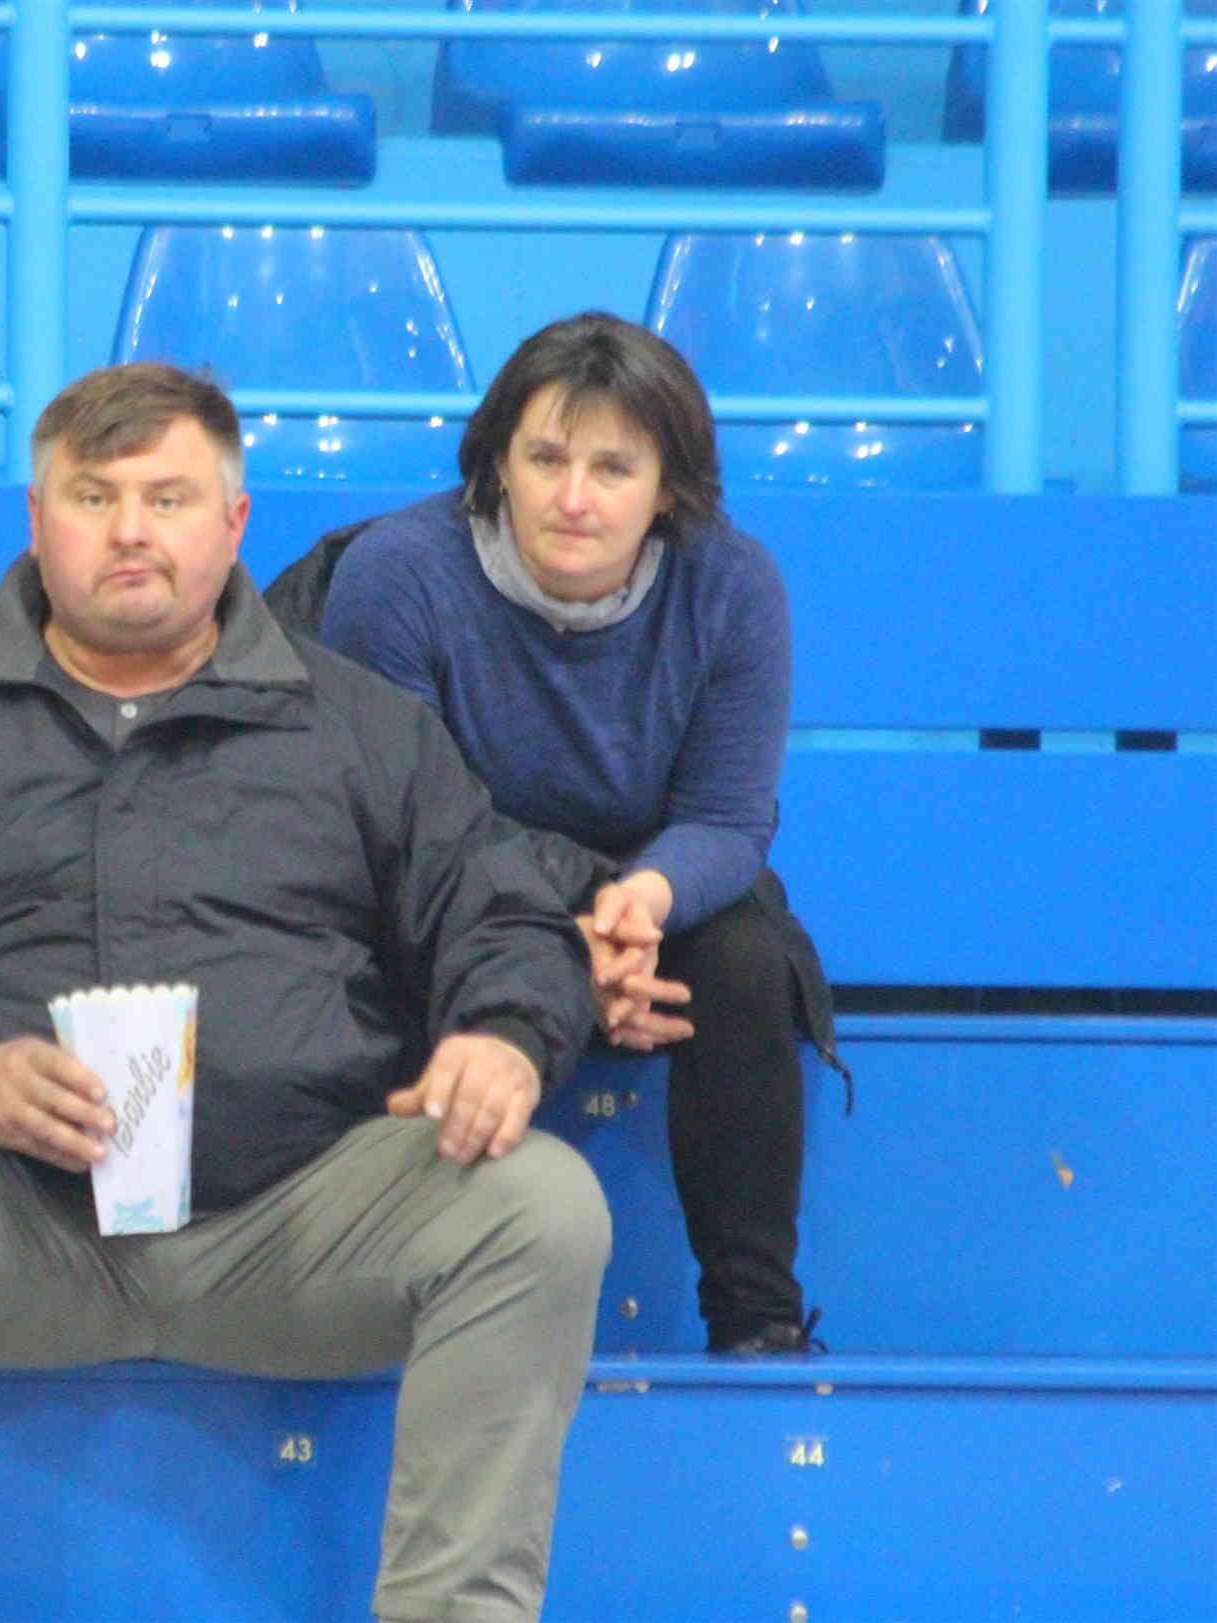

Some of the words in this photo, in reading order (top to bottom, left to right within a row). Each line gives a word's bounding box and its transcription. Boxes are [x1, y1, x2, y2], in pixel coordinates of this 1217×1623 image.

[585, 1094, 615, 1117] 48
[280, 1438, 311, 1462] 43
[790, 1440, 824, 1467] 44
